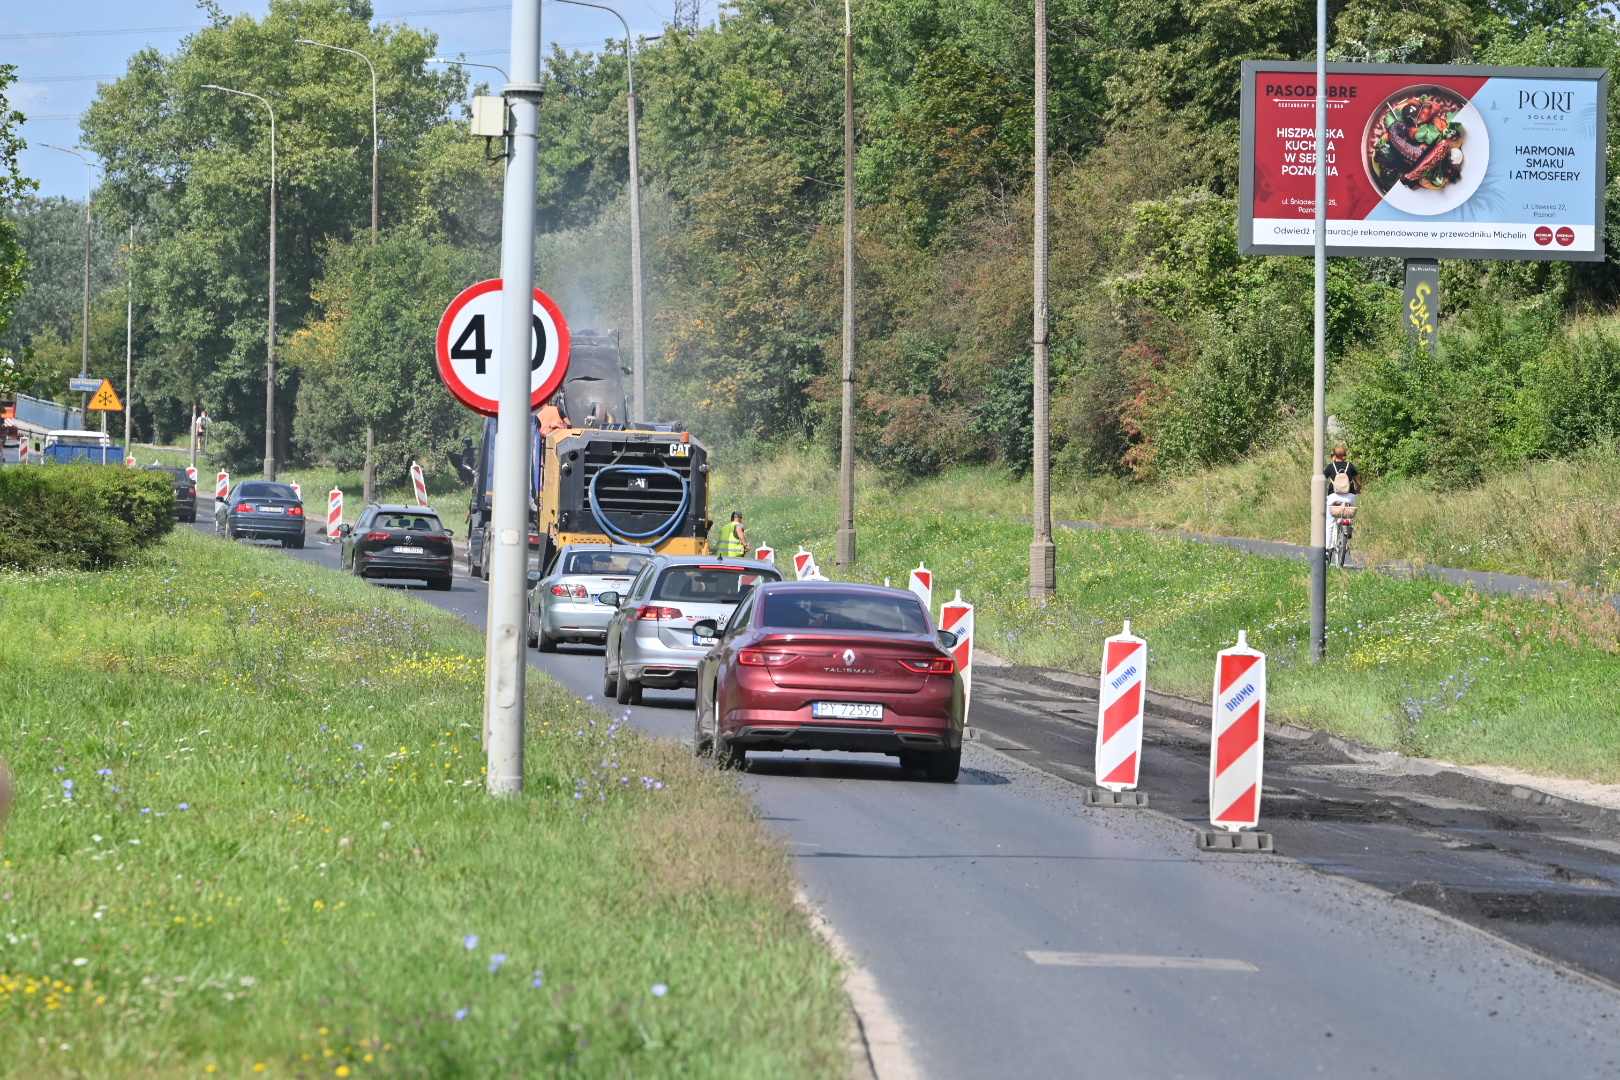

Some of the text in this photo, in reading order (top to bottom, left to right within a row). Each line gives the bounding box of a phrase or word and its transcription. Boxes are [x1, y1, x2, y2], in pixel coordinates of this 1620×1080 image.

[1266, 85, 1357, 98] PASODBRE
[1519, 90, 1575, 113] PORT
[1284, 153, 1296, 162] W
[1516, 146, 1575, 156] HARMONIA
[1526, 158, 1564, 168] SMAKU
[1516, 171, 1580, 181] ATMOSFERY
[1274, 226, 1310, 234] Odwiedź
[1360, 228, 1428, 238] rekomendowane
[1440, 230, 1492, 238] przewodniku
[1494, 231, 1526, 239] Michelin
[670, 444, 690, 457] CAT
[1111, 666, 1136, 690] DROMO
[1225, 684, 1254, 712] DROMO
[820, 703, 836, 714] PY
[842, 704, 878, 716] 72596
